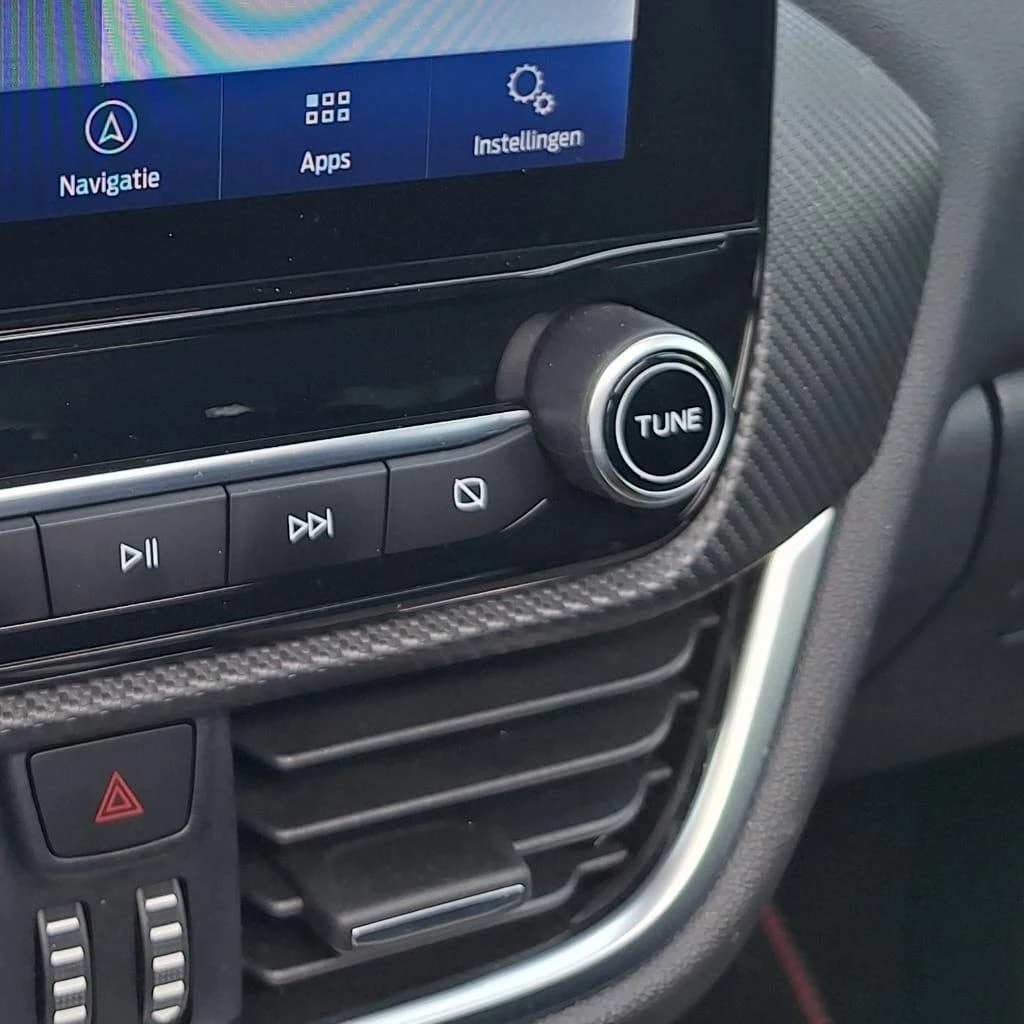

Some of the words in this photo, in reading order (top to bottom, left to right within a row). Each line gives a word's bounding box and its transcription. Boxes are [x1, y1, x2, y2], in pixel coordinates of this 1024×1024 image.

[473, 127, 584, 156] Instellingen
[300, 150, 352, 176] Apps
[59, 167, 161, 198] Navigatie
[634, 406, 703, 439] TUNE
